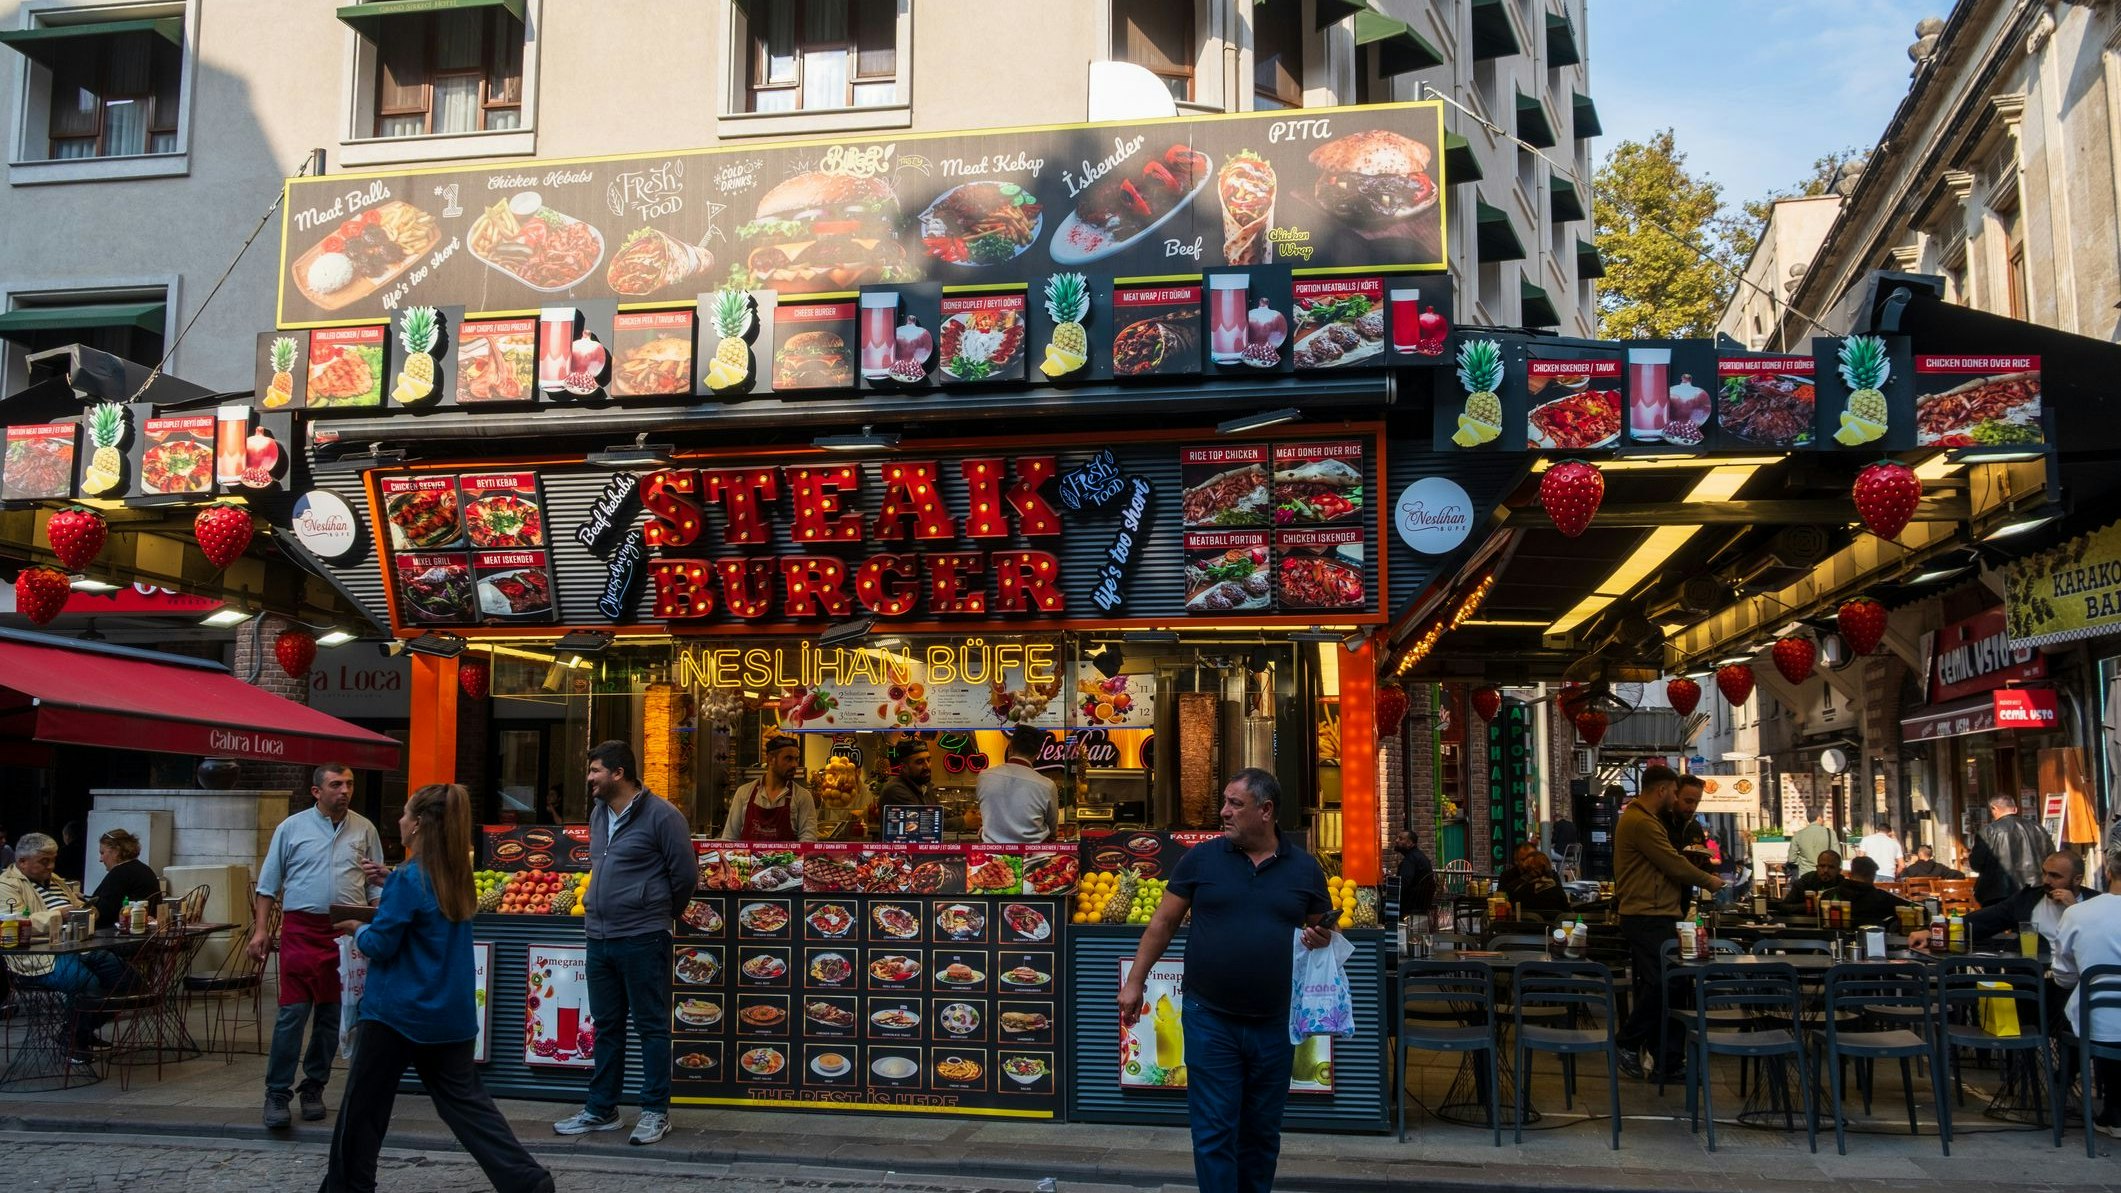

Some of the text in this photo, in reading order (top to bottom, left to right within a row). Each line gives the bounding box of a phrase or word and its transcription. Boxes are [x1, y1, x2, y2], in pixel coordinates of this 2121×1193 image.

[1269, 119, 1332, 144] PITA
[722, 165, 744, 180] COLD
[940, 152, 1044, 178] Meat Kebap
[1062, 134, 1145, 199] İskender
[487, 169, 593, 190] Chicken Kebabs
[720, 174, 752, 192] DRINKS
[295, 180, 391, 232] Meat Balls
[637, 196, 683, 222] FOOD
[1268, 227, 1310, 241] Chicken
[1164, 236, 1203, 260] Beef
[1279, 242, 1313, 260] Wrap
[410, 267, 428, 287] too
[430, 237, 461, 270] short
[1123, 289, 1191, 301] MEAT WRAP ET DÜRÜM
[1296, 279, 1379, 293] PORTION MEATBALLS KÖFTE
[794, 307, 837, 317] CHEESE BURGER
[1533, 363, 1560, 372] CHICKEN
[1596, 362, 1615, 372] TAVUK
[1719, 360, 1744, 370] PORTION
[1745, 360, 1761, 370] MEAT
[1786, 359, 1793, 369] ET
[1926, 358, 2030, 368] CHICKEN DONER OVER RICE
[1189, 449, 1258, 461] RICE TOP CHICKEN
[1276, 445, 1361, 458] MEAT DONER OVER RICE
[390, 481, 418, 491] CHICKEN
[476, 477, 518, 488] BEYTI KEBAB
[599, 476, 635, 517] kebabs
[1089, 478, 1125, 506] FOOD
[640, 456, 1062, 547] STEAK
[303, 514, 347, 531] Neslihan
[1109, 532, 1133, 564] too
[1121, 478, 1150, 532] short
[1410, 505, 1466, 525] Neslihan
[1189, 534, 1263, 546] MEATBALL PORTION
[1283, 531, 1356, 543] CHICKEN ISKENDER
[433, 556, 451, 566] GRILL
[483, 554, 534, 565] MEAT ISKENDER
[649, 551, 1066, 618] BURGER
[2053, 560, 2121, 597] KARAKO
[680, 638, 1056, 689] NESLİHAN BÜFE
[340, 665, 400, 691] Loca
[210, 729, 283, 755] Cabra Loca
[1510, 708, 1526, 844] APOTHEK
[748, 1088, 795, 1103] THE
